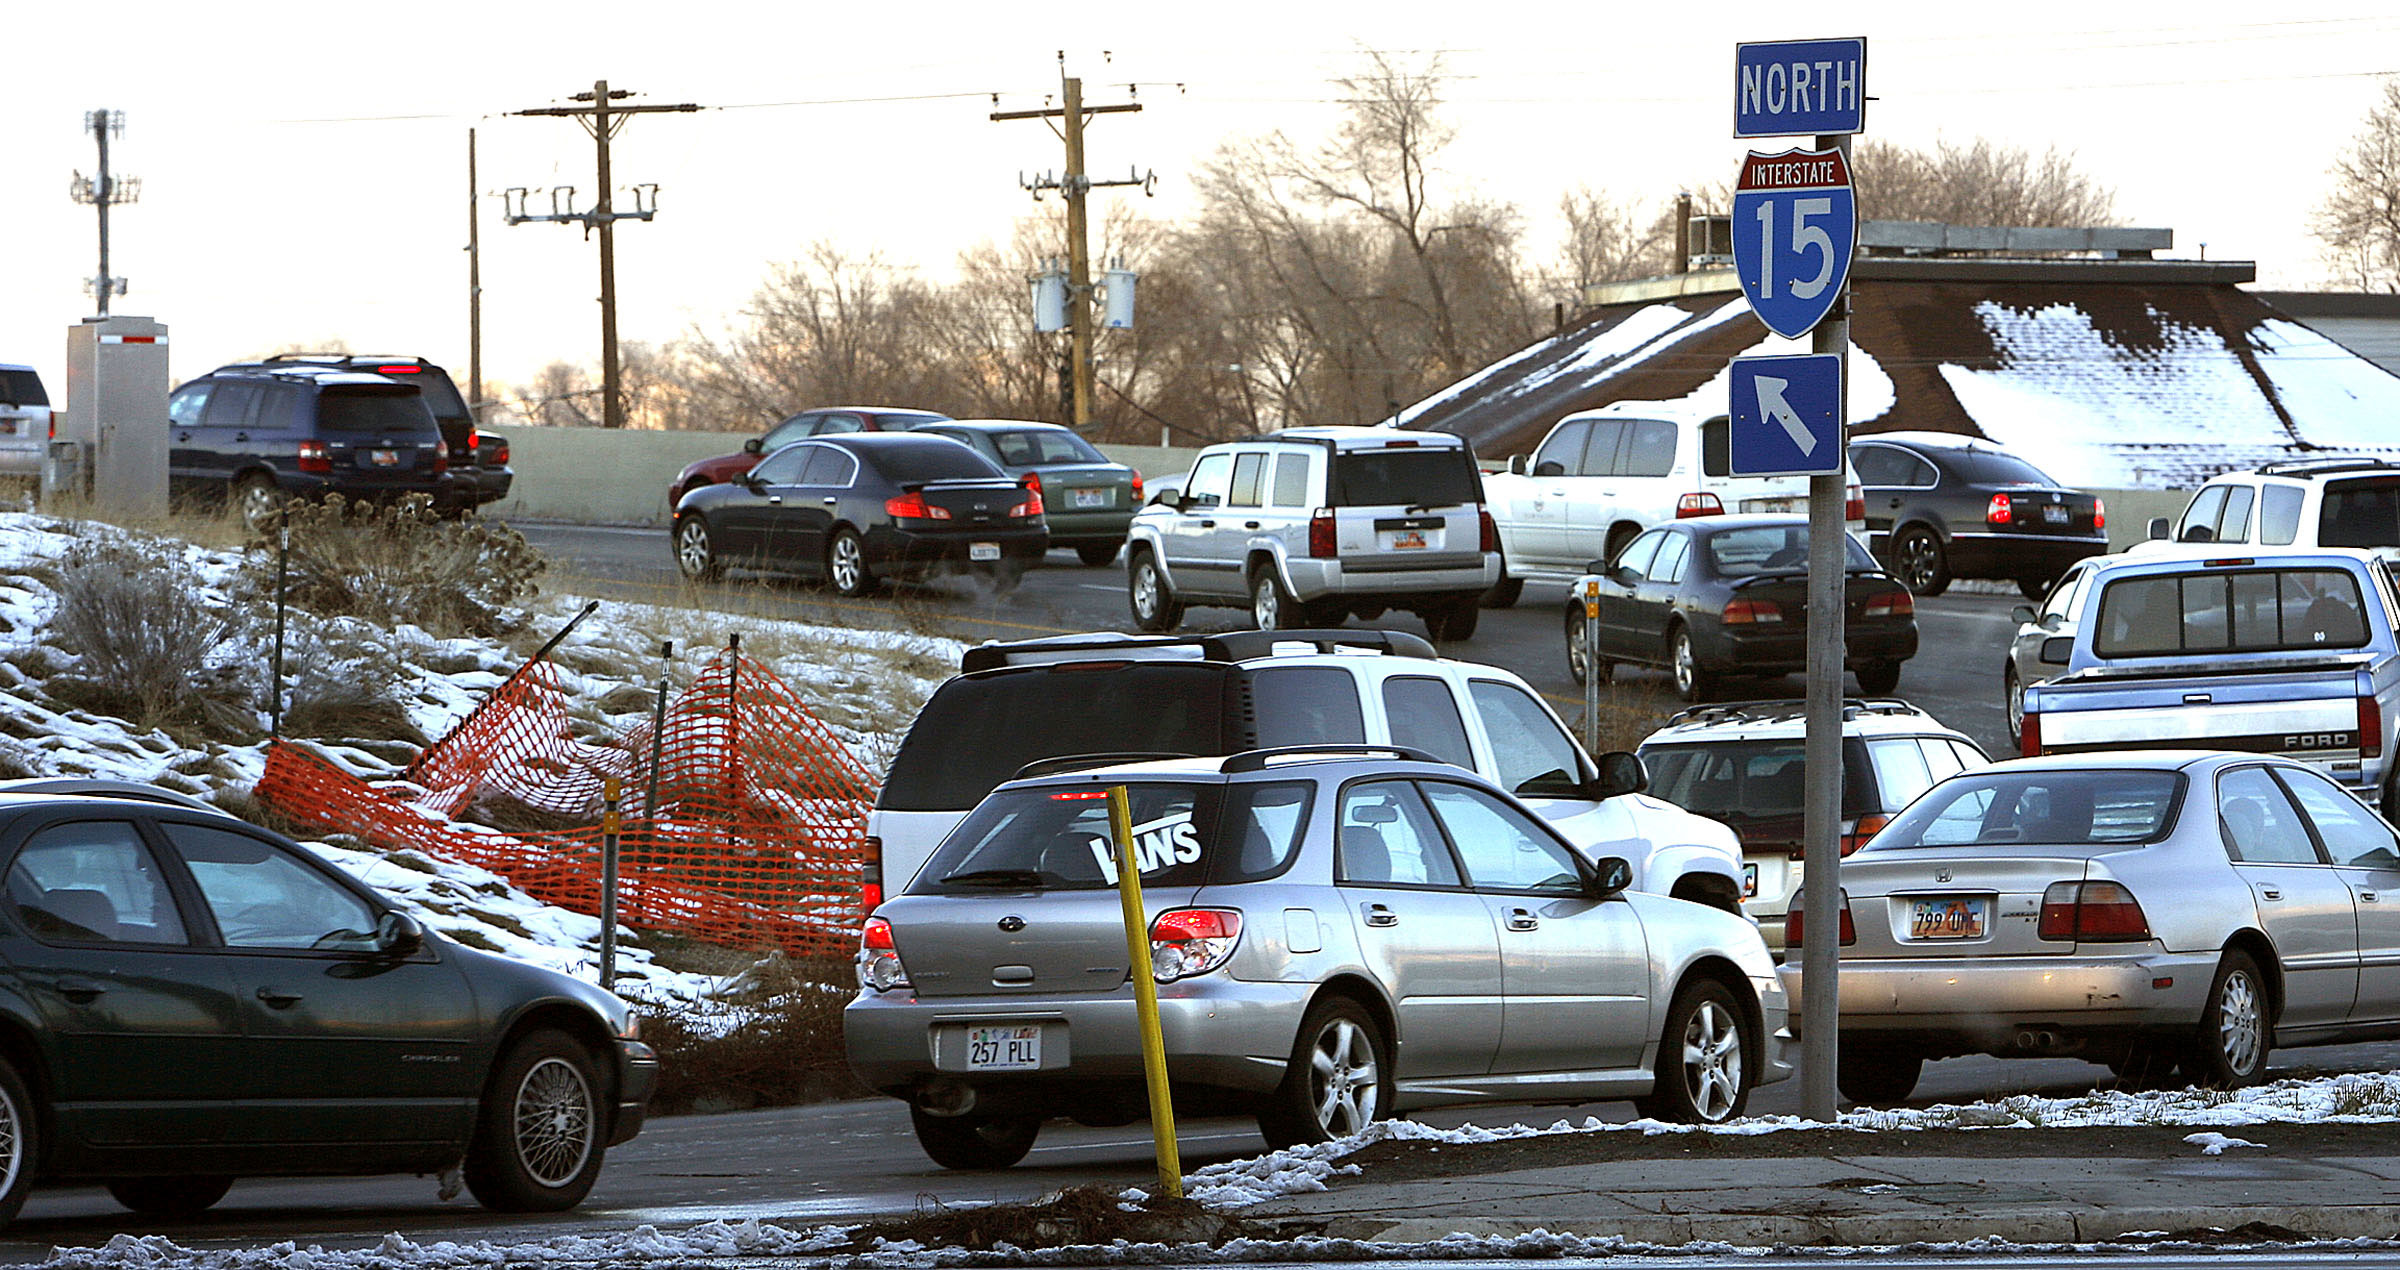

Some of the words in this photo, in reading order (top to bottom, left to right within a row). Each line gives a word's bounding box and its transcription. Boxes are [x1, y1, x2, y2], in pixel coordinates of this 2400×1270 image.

[1742, 60, 1856, 115] NORTH
[1752, 161, 1835, 186] INTERSTATE
[1756, 197, 1835, 299] 15
[2284, 733, 2348, 748] FORD
[1916, 912, 1943, 932] 799
[971, 1041, 999, 1064] 257
[1009, 1041, 1036, 1062] PLL
